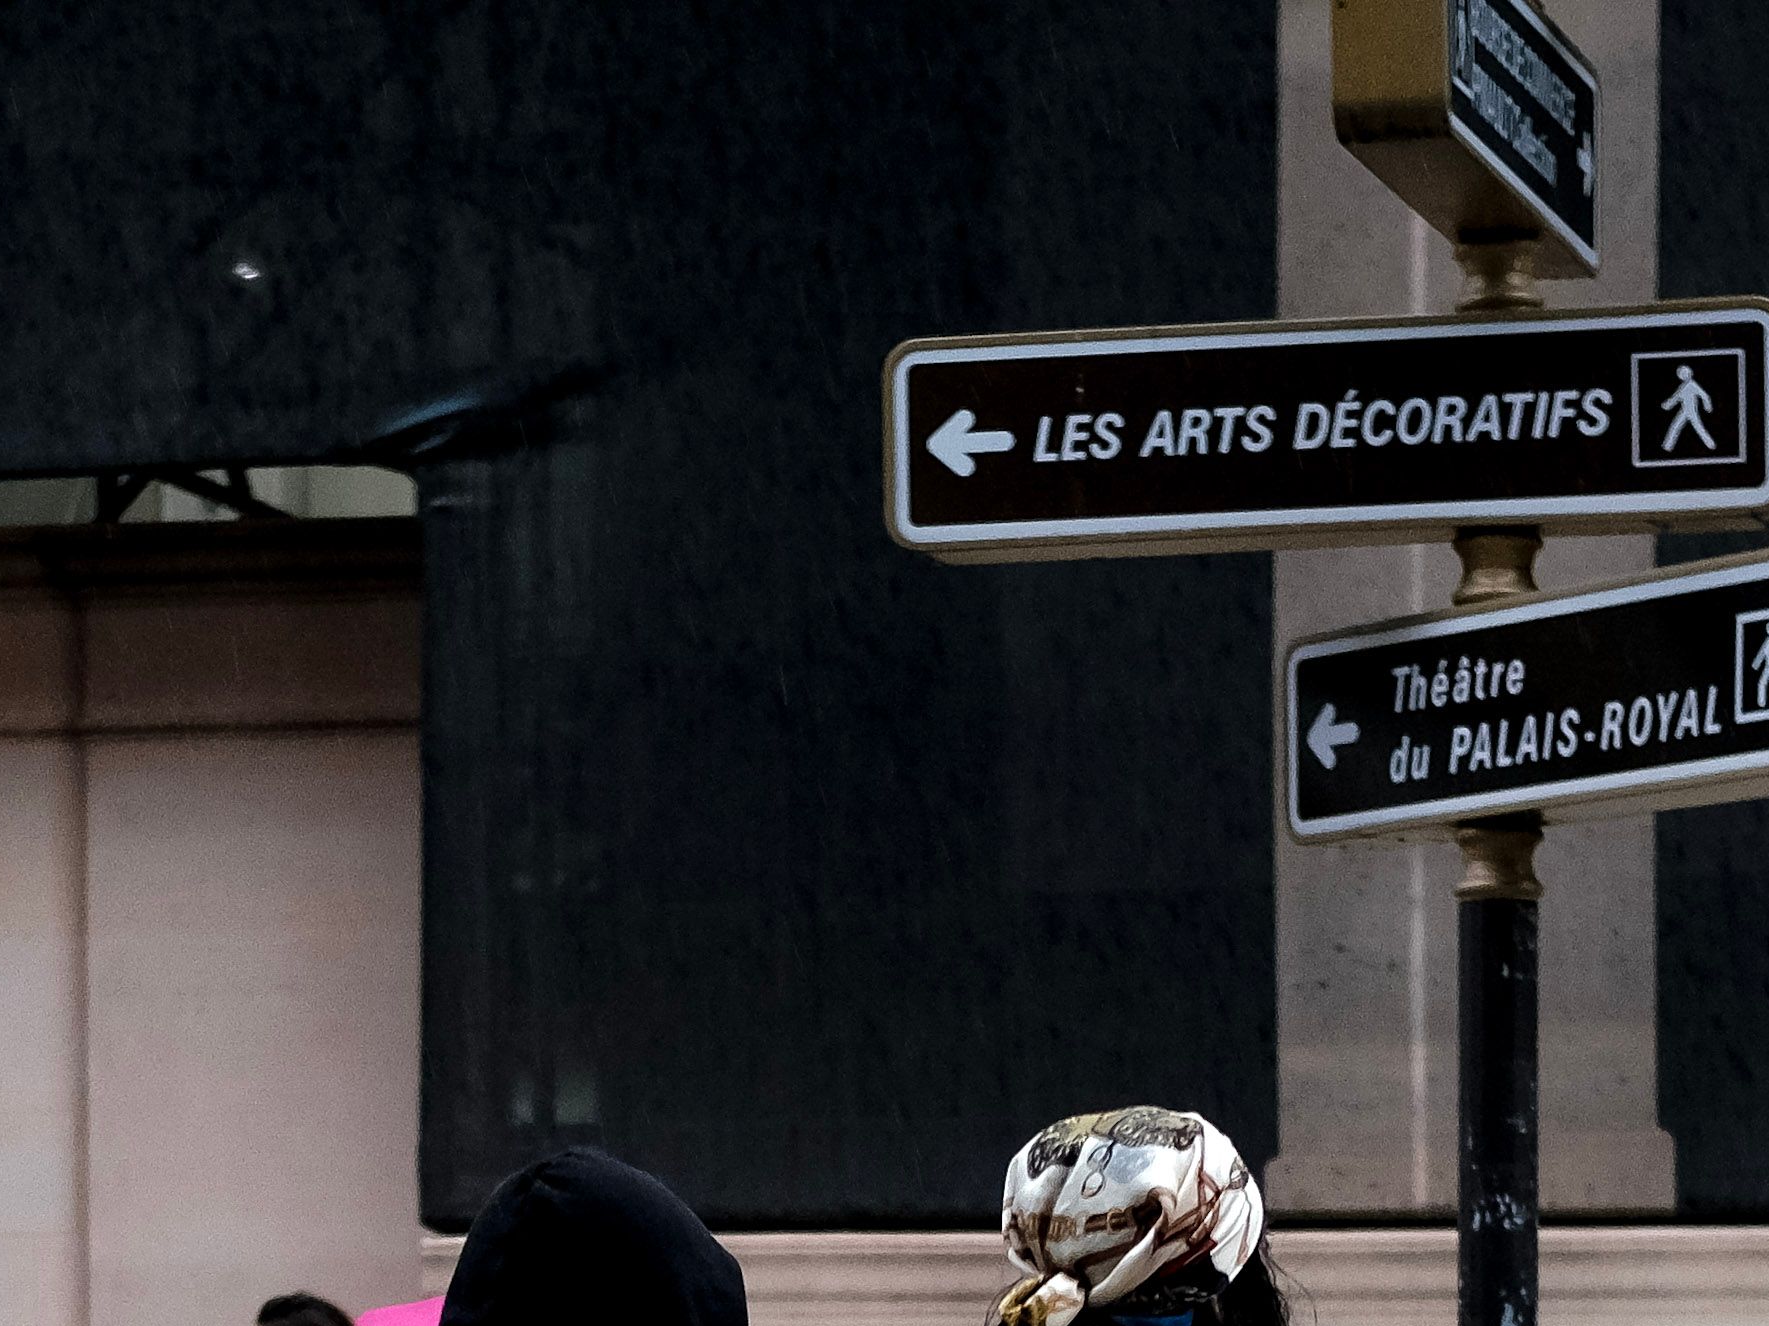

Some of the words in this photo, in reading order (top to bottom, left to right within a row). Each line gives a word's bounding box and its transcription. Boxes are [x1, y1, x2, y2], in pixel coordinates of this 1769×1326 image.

[1032, 412, 1126, 463] LES
[1138, 404, 1278, 457] ARTS
[1292, 388, 1613, 450] DÉCORATIFS
[1390, 653, 1527, 713] Théâtre
[1389, 734, 1431, 784] du
[1448, 684, 1723, 775] PALAIS-ROYAL
